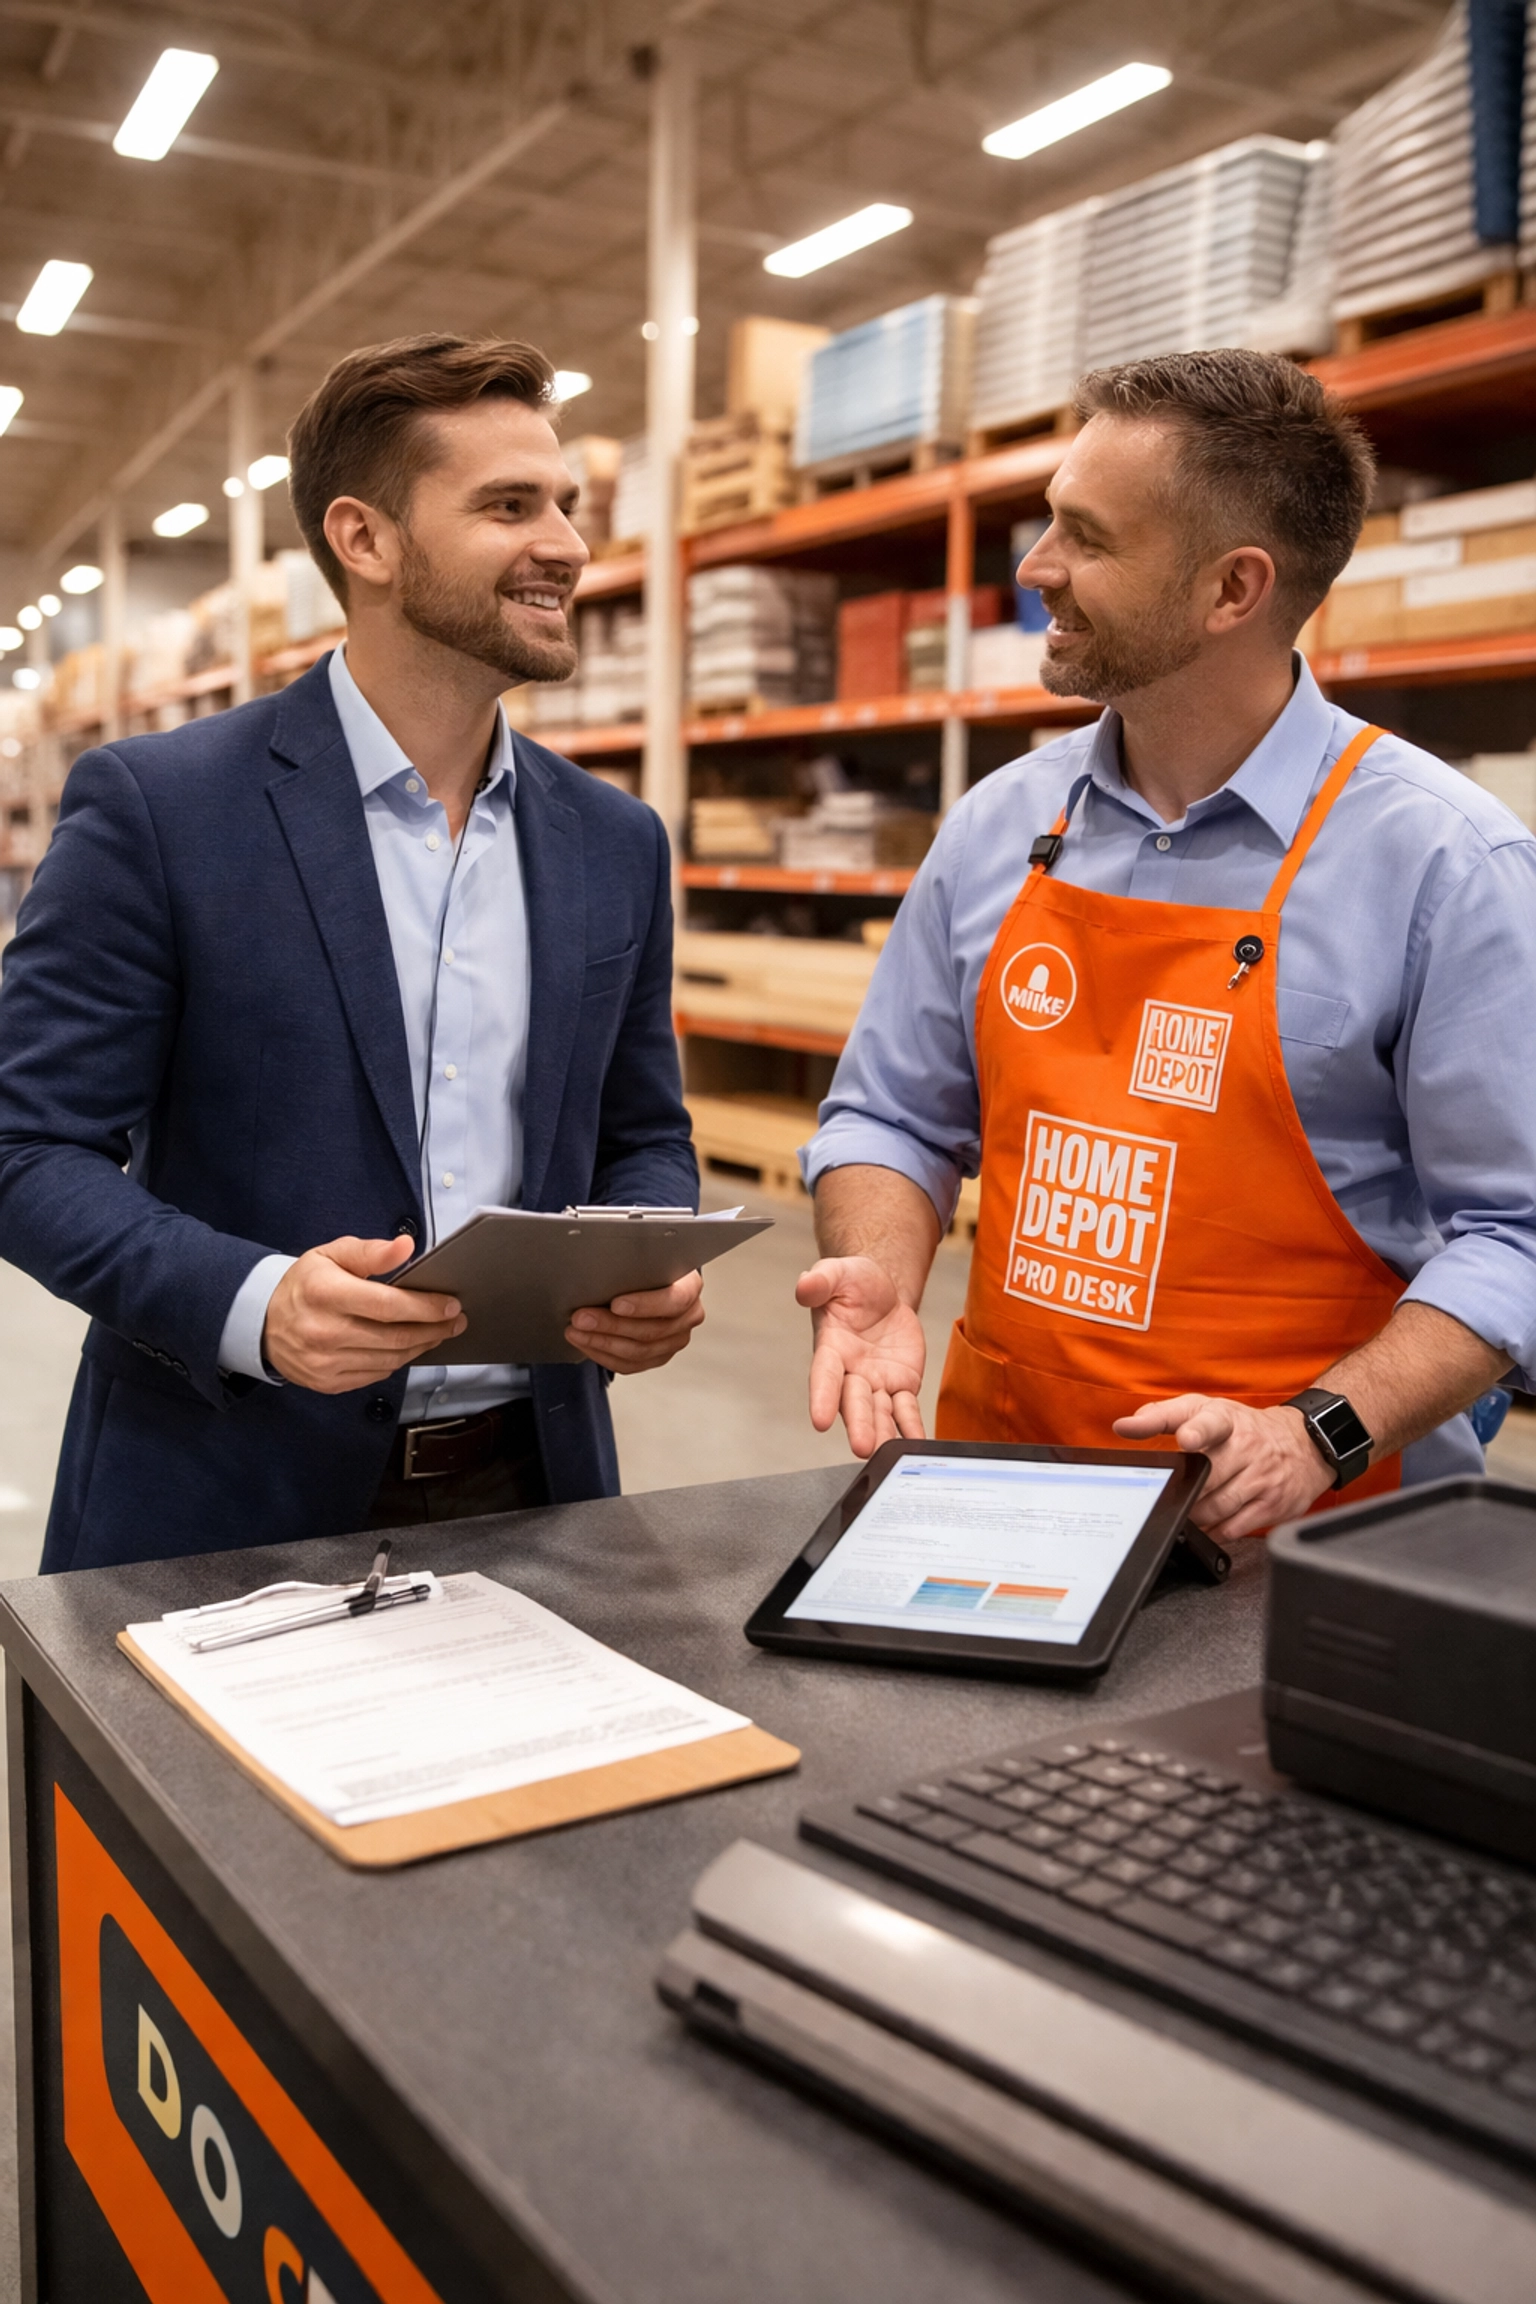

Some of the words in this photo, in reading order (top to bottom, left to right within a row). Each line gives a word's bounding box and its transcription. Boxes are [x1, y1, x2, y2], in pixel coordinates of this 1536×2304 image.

[1142, 1053, 1213, 1096] DEPOT
[1032, 1126, 1159, 1206] HOME
[1021, 1183, 1156, 1266] DEPOT
[1012, 1255, 1057, 1296] PRO
[1063, 1274, 1139, 1316] DESK
[138, 2003, 338, 2304] DOC
